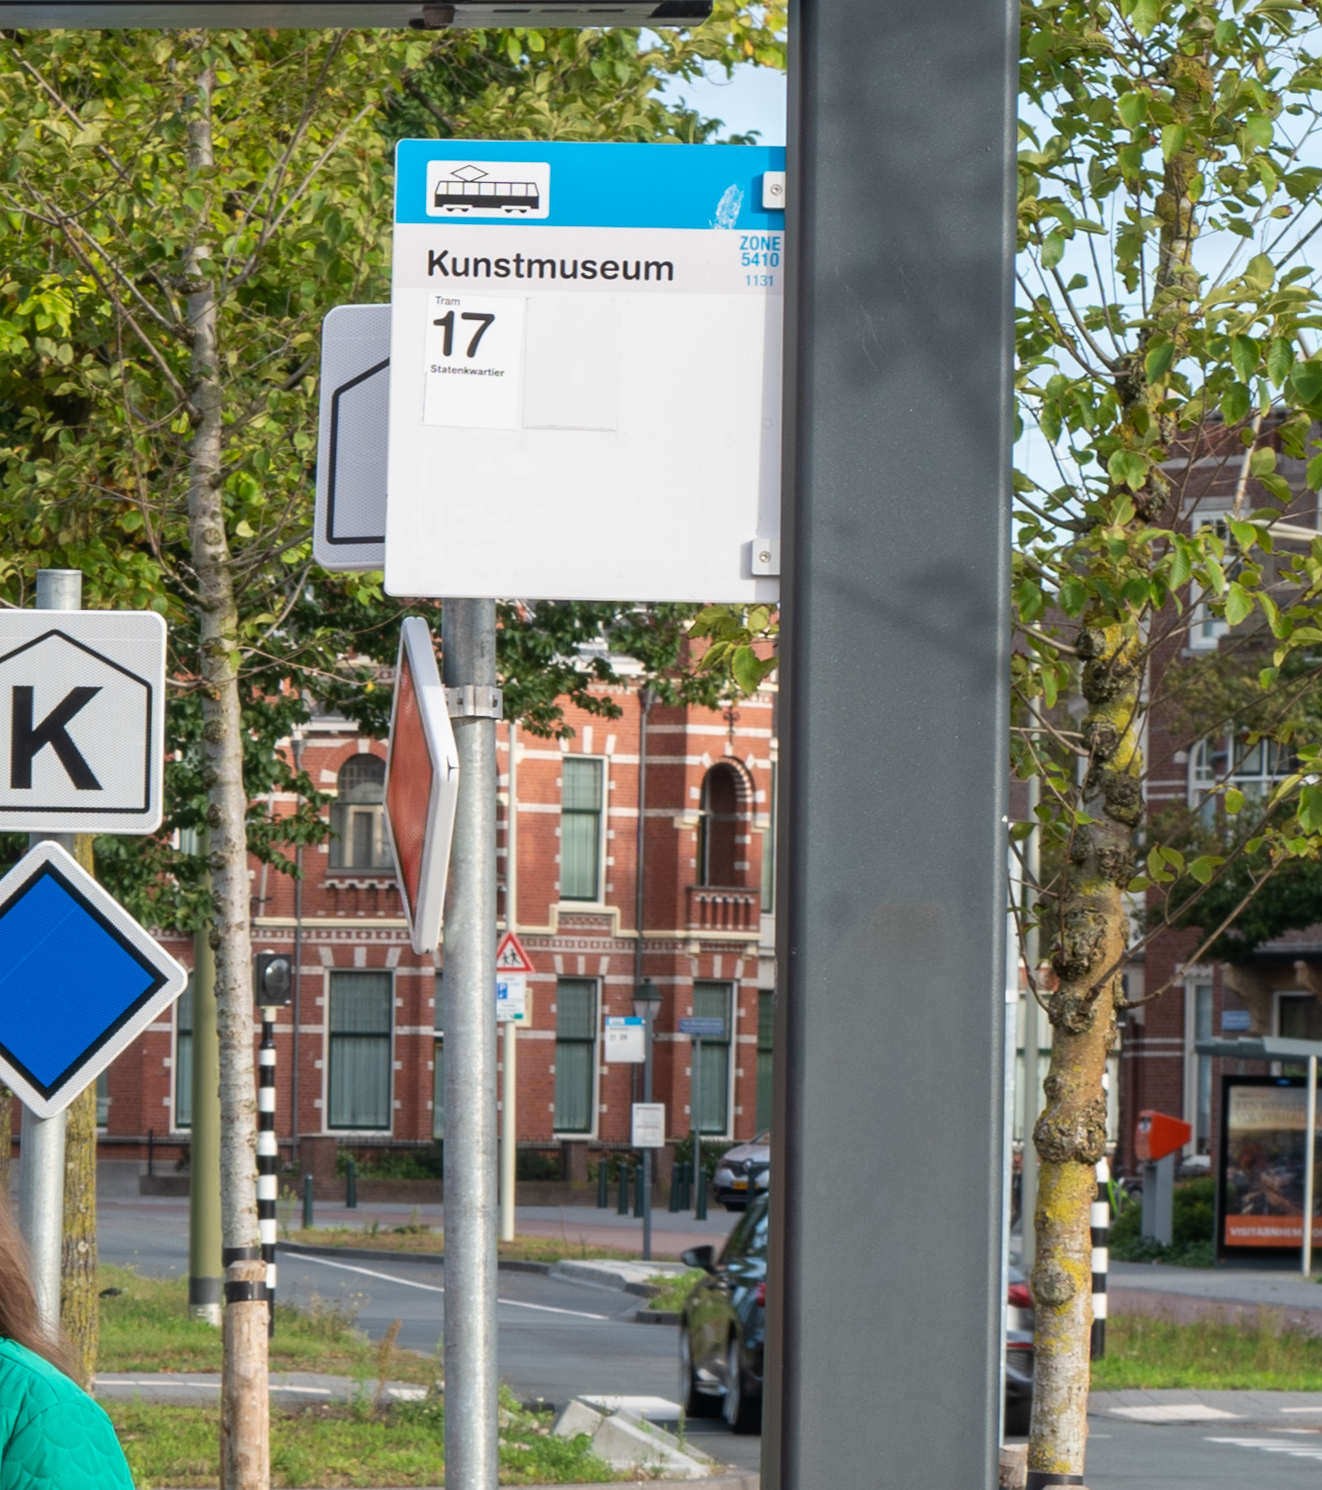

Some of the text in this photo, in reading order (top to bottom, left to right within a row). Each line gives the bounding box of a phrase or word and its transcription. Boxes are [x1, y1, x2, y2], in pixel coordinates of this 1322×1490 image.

[739, 235, 781, 251] ZONE
[426, 249, 674, 281] Kunstmuseum
[741, 252, 780, 267] 5410
[746, 275, 774, 286] 1131
[435, 295, 461, 306] Tram
[432, 310, 496, 358] 17
[430, 364, 505, 377] Statenkwartier
[9, 685, 104, 791] K
